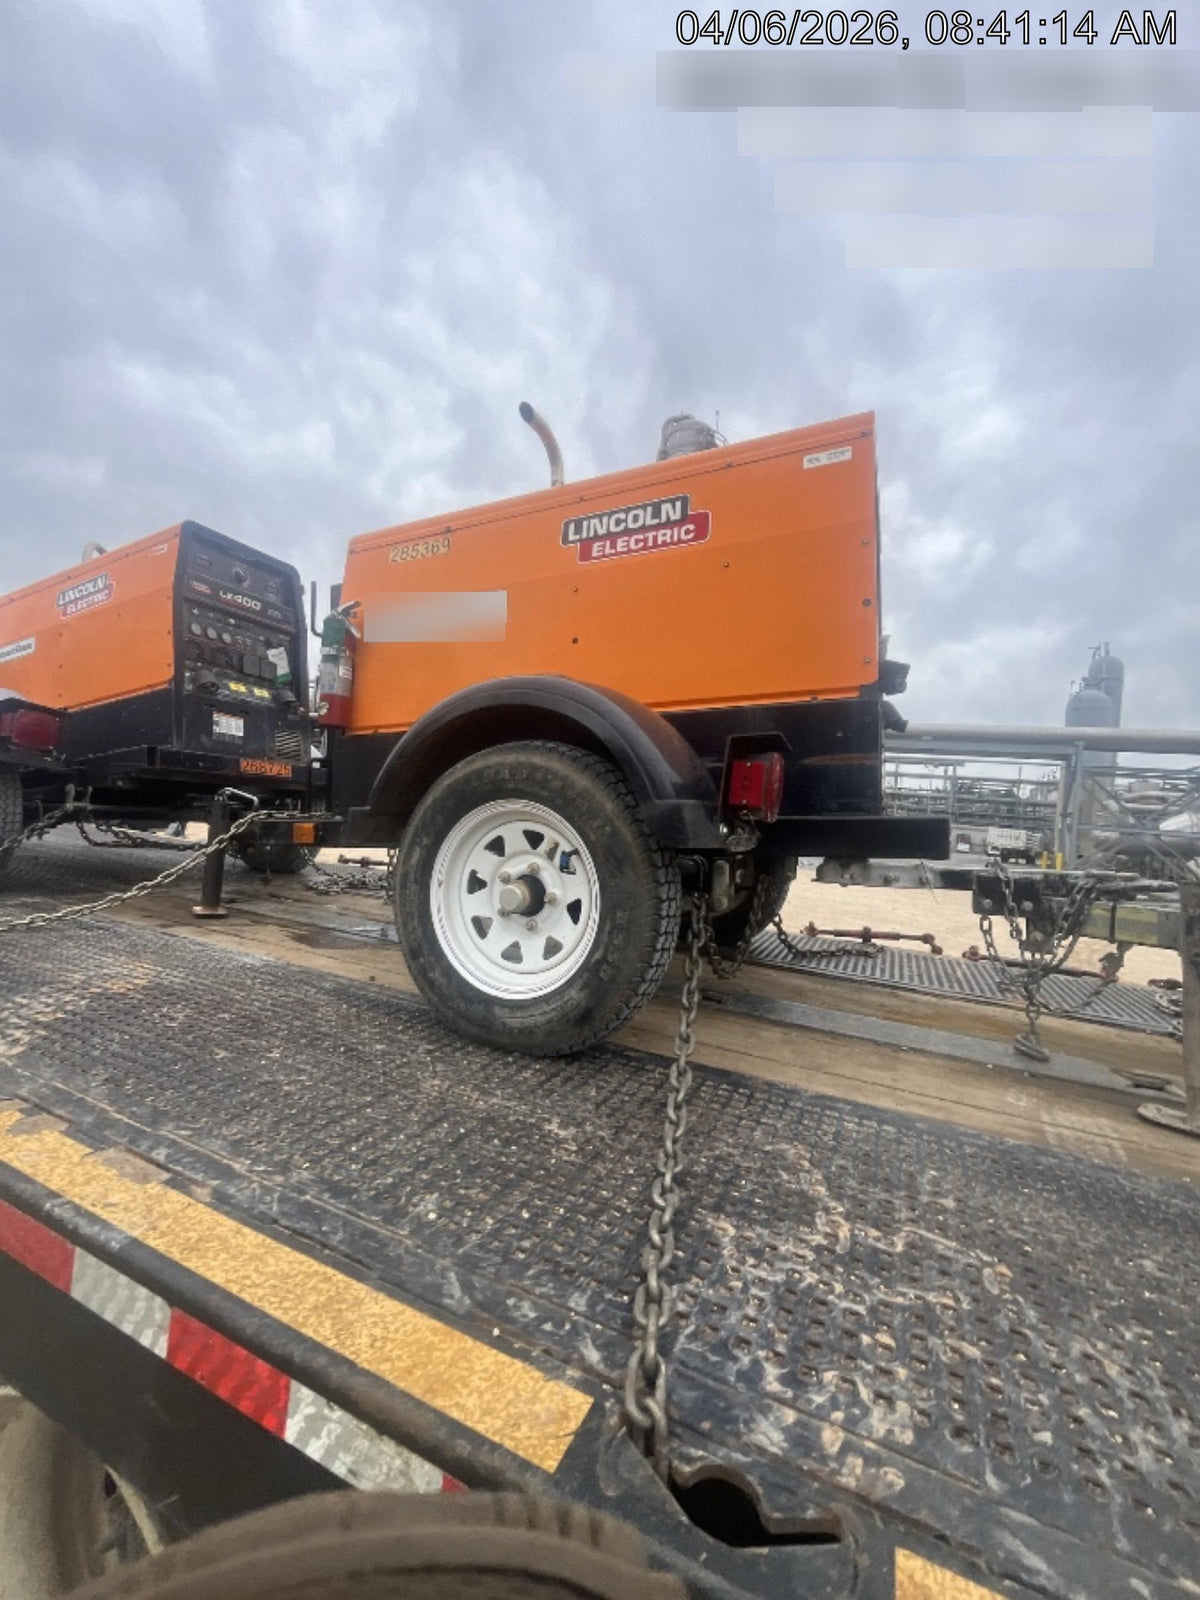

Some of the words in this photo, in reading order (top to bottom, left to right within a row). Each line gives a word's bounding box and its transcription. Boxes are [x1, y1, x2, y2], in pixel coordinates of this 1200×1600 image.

[568, 499, 682, 541] LINCOLN
[390, 536, 451, 562] 285369
[591, 523, 696, 557] ELECTRIC
[58, 575, 106, 605] LINCOLN
